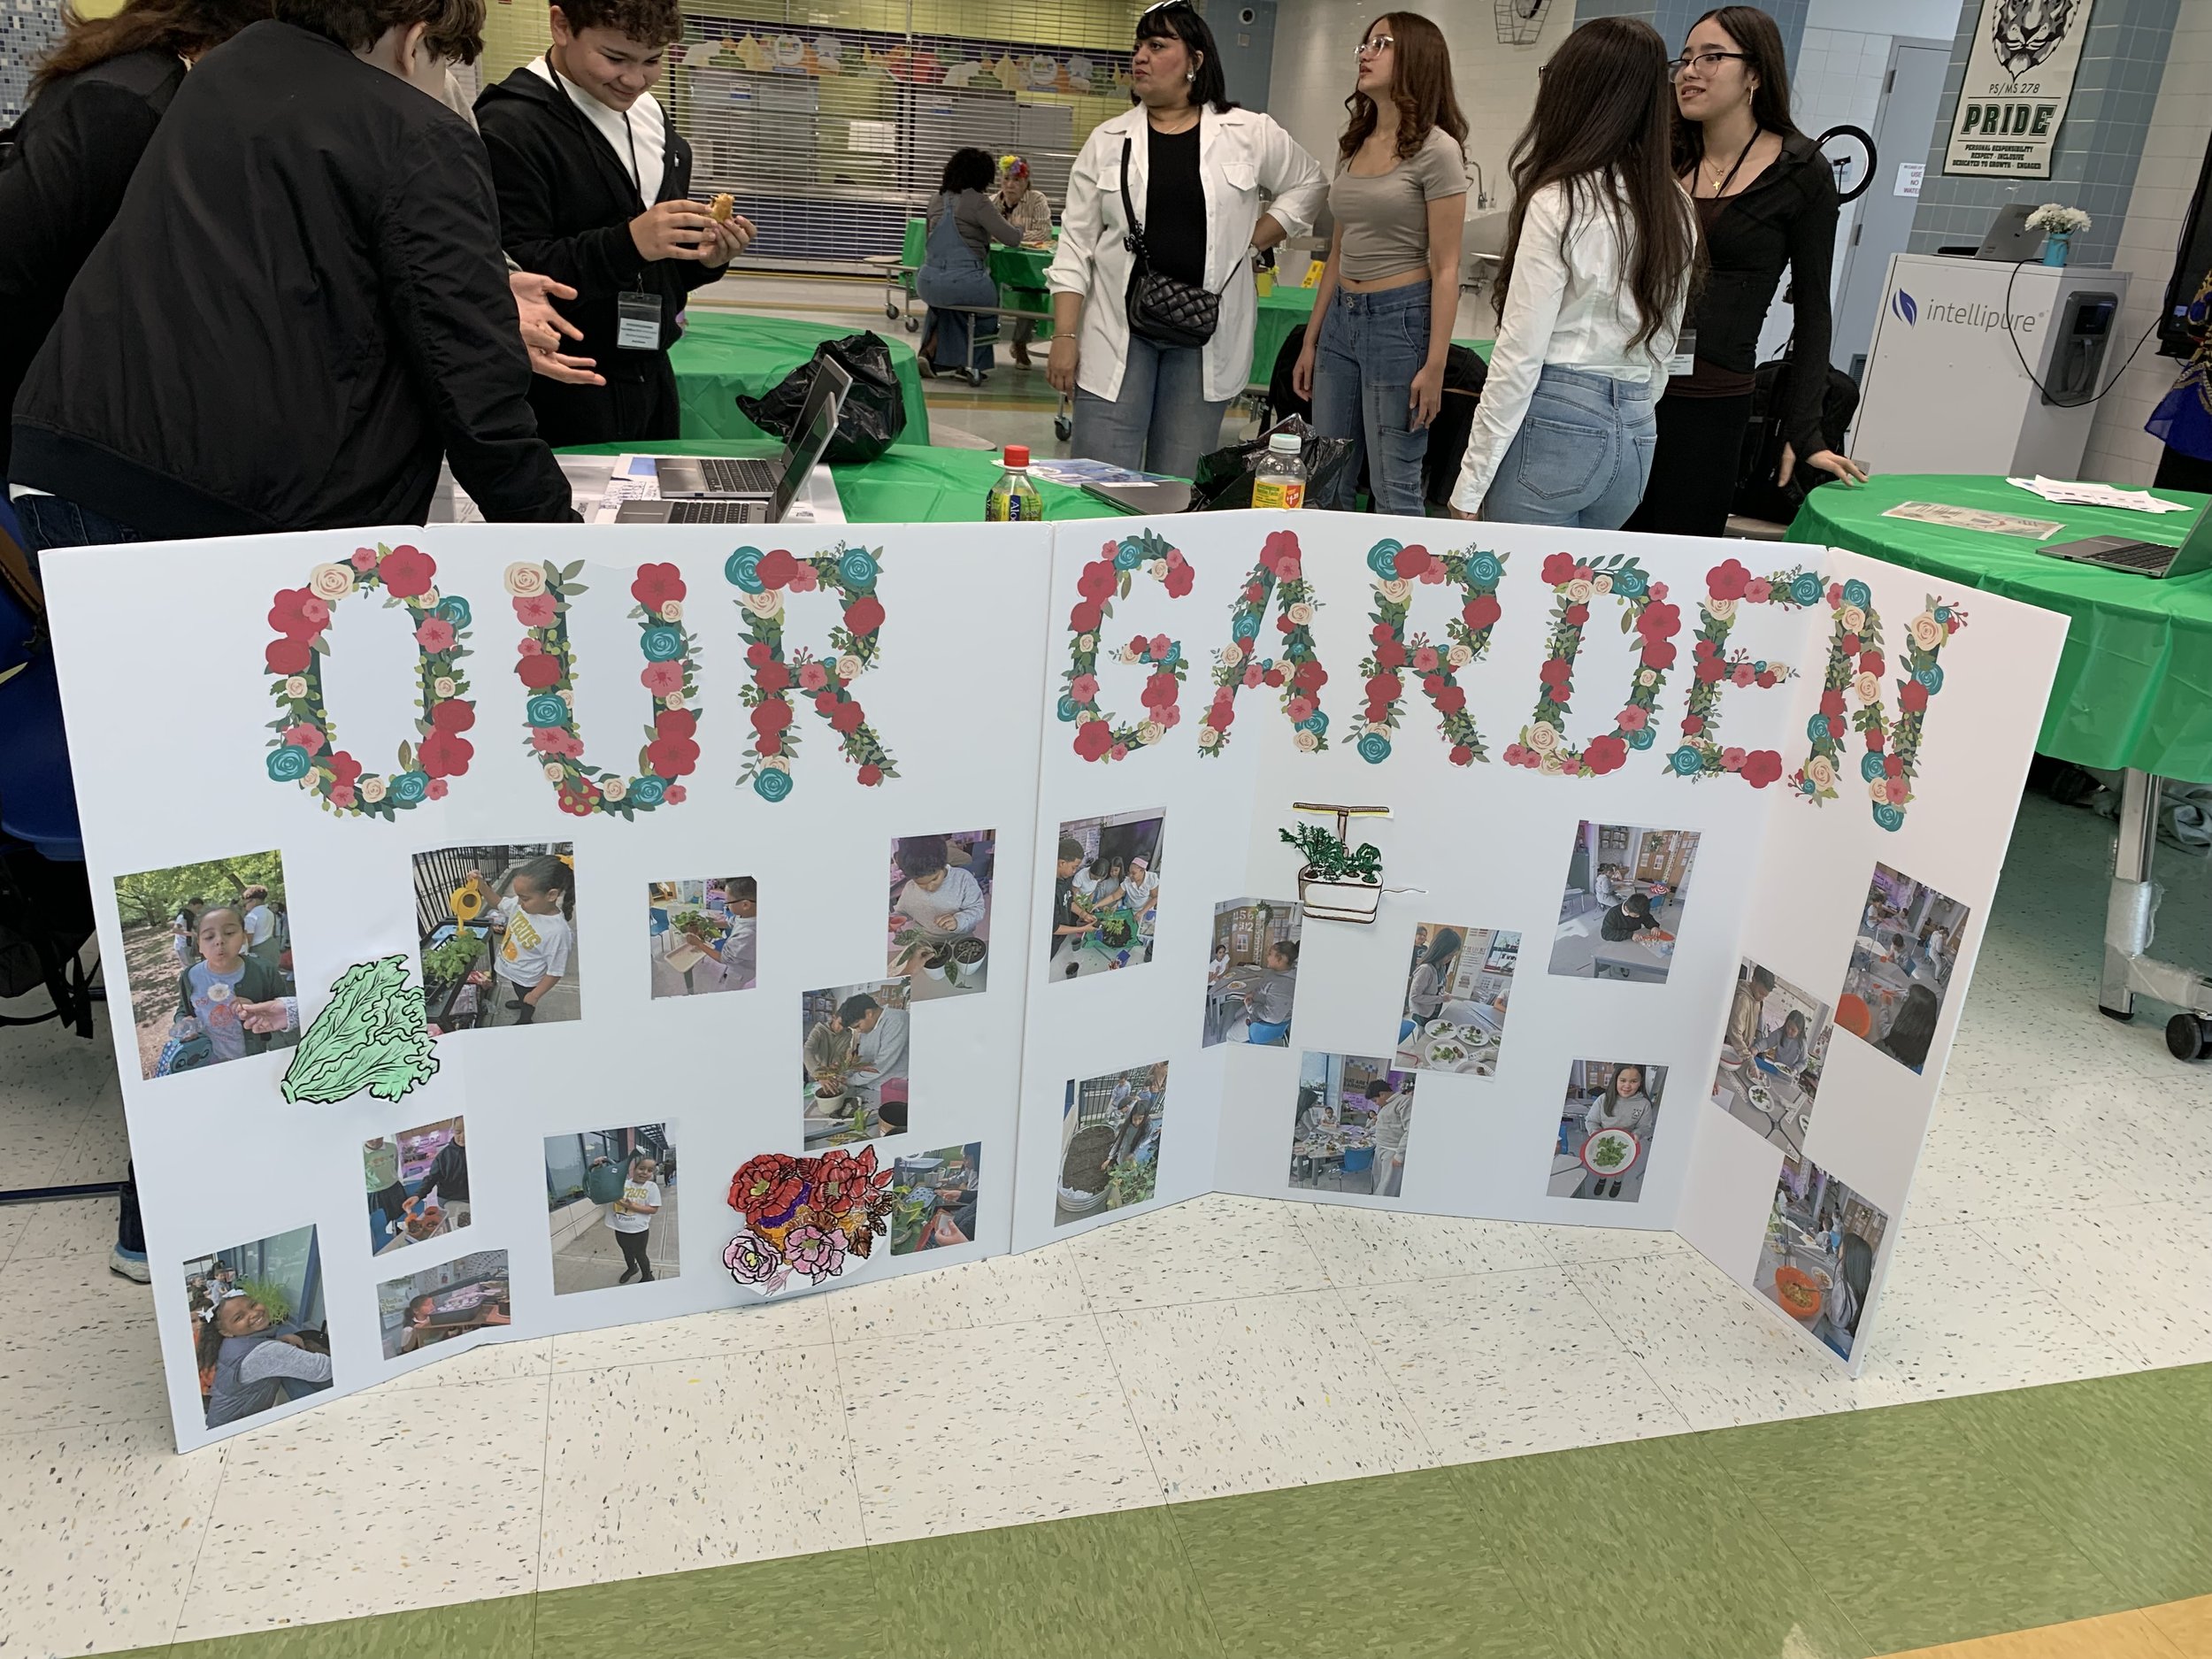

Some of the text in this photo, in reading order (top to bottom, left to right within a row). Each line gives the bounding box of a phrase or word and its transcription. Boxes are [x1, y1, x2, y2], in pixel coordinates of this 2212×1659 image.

[1989, 82, 2040, 96] PS/MS 278
[1961, 104, 2058, 136] PRIDE
[1992, 144, 2033, 153] RESPONSIBILITY
[1927, 298, 2037, 333] intellipure
[265, 540, 902, 823] OUR
[1057, 527, 1969, 833] GARDEN
